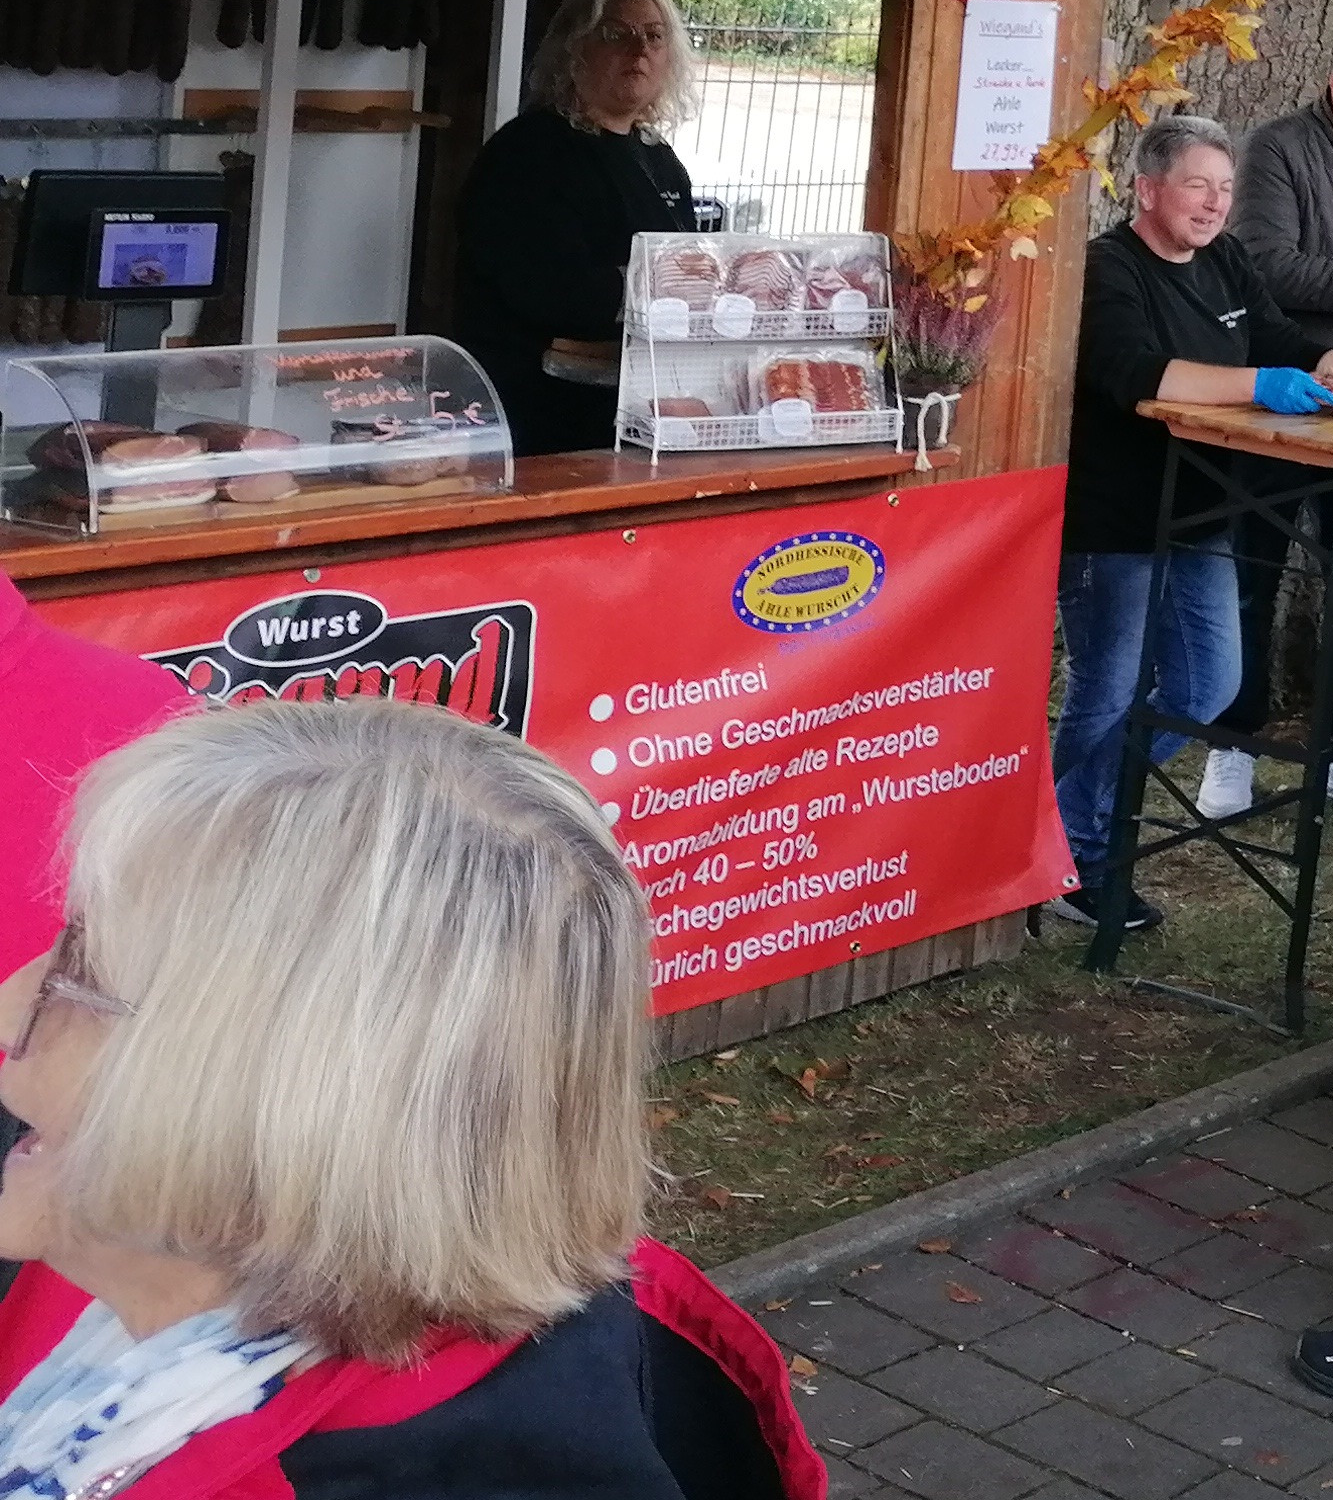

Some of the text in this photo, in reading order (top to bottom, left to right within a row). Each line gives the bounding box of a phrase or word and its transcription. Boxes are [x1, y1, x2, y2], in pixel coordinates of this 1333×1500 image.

[756, 545, 866, 581] NORDHESSISCHE
[257, 609, 362, 647] Wurst
[755, 582, 861, 619] AHLE WURSCHT
[625, 662, 768, 715] Glutenfrei
[628, 665, 995, 769] Ohne Geschmacksverstärker
[630, 723, 940, 821] Überlieferte alte Rezepte
[622, 803, 799, 870] Aromabildung
[806, 792, 845, 822] am
[691, 852, 729, 887] 40
[762, 831, 818, 872] 50%
[724, 890, 917, 973] geschmackvoll
